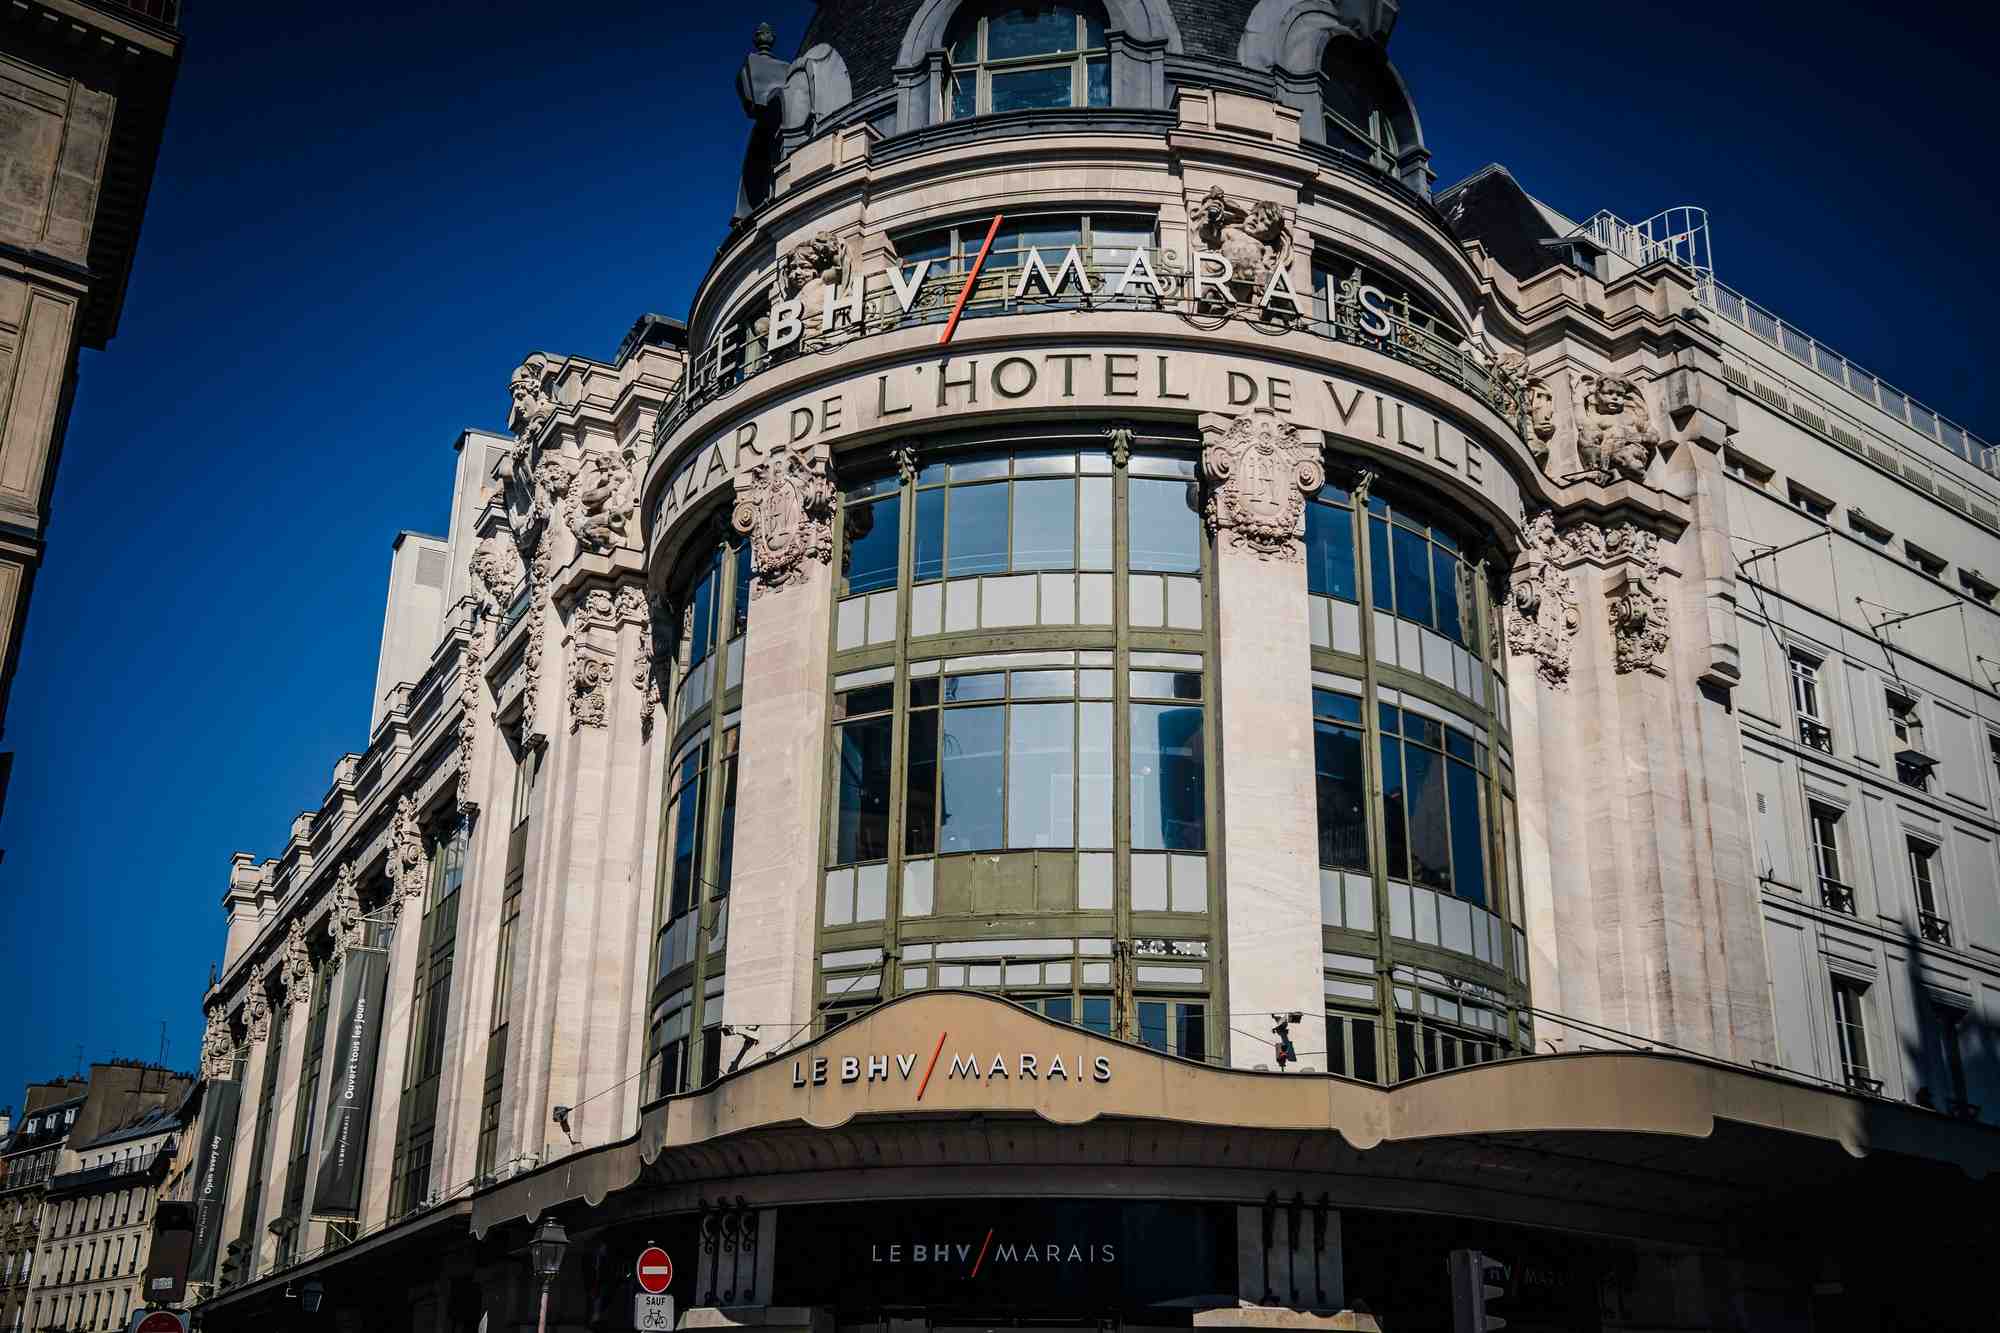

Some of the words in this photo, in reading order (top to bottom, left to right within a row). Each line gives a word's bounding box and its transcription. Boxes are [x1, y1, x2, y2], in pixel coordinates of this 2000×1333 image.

[789, 394, 844, 443] DE
[1226, 370, 1293, 415] DE
[1322, 379, 1483, 486] VILLE
[351, 1024, 362, 1038] les
[351, 1041, 360, 1062] tous
[344, 1064, 357, 1099] Ouvert
[792, 1058, 828, 1088] LE
[204, 1173, 216, 1194] Open
[211, 1135, 221, 1150] day
[871, 1243, 902, 1263] LE
[646, 1296, 666, 1306] SAUF
